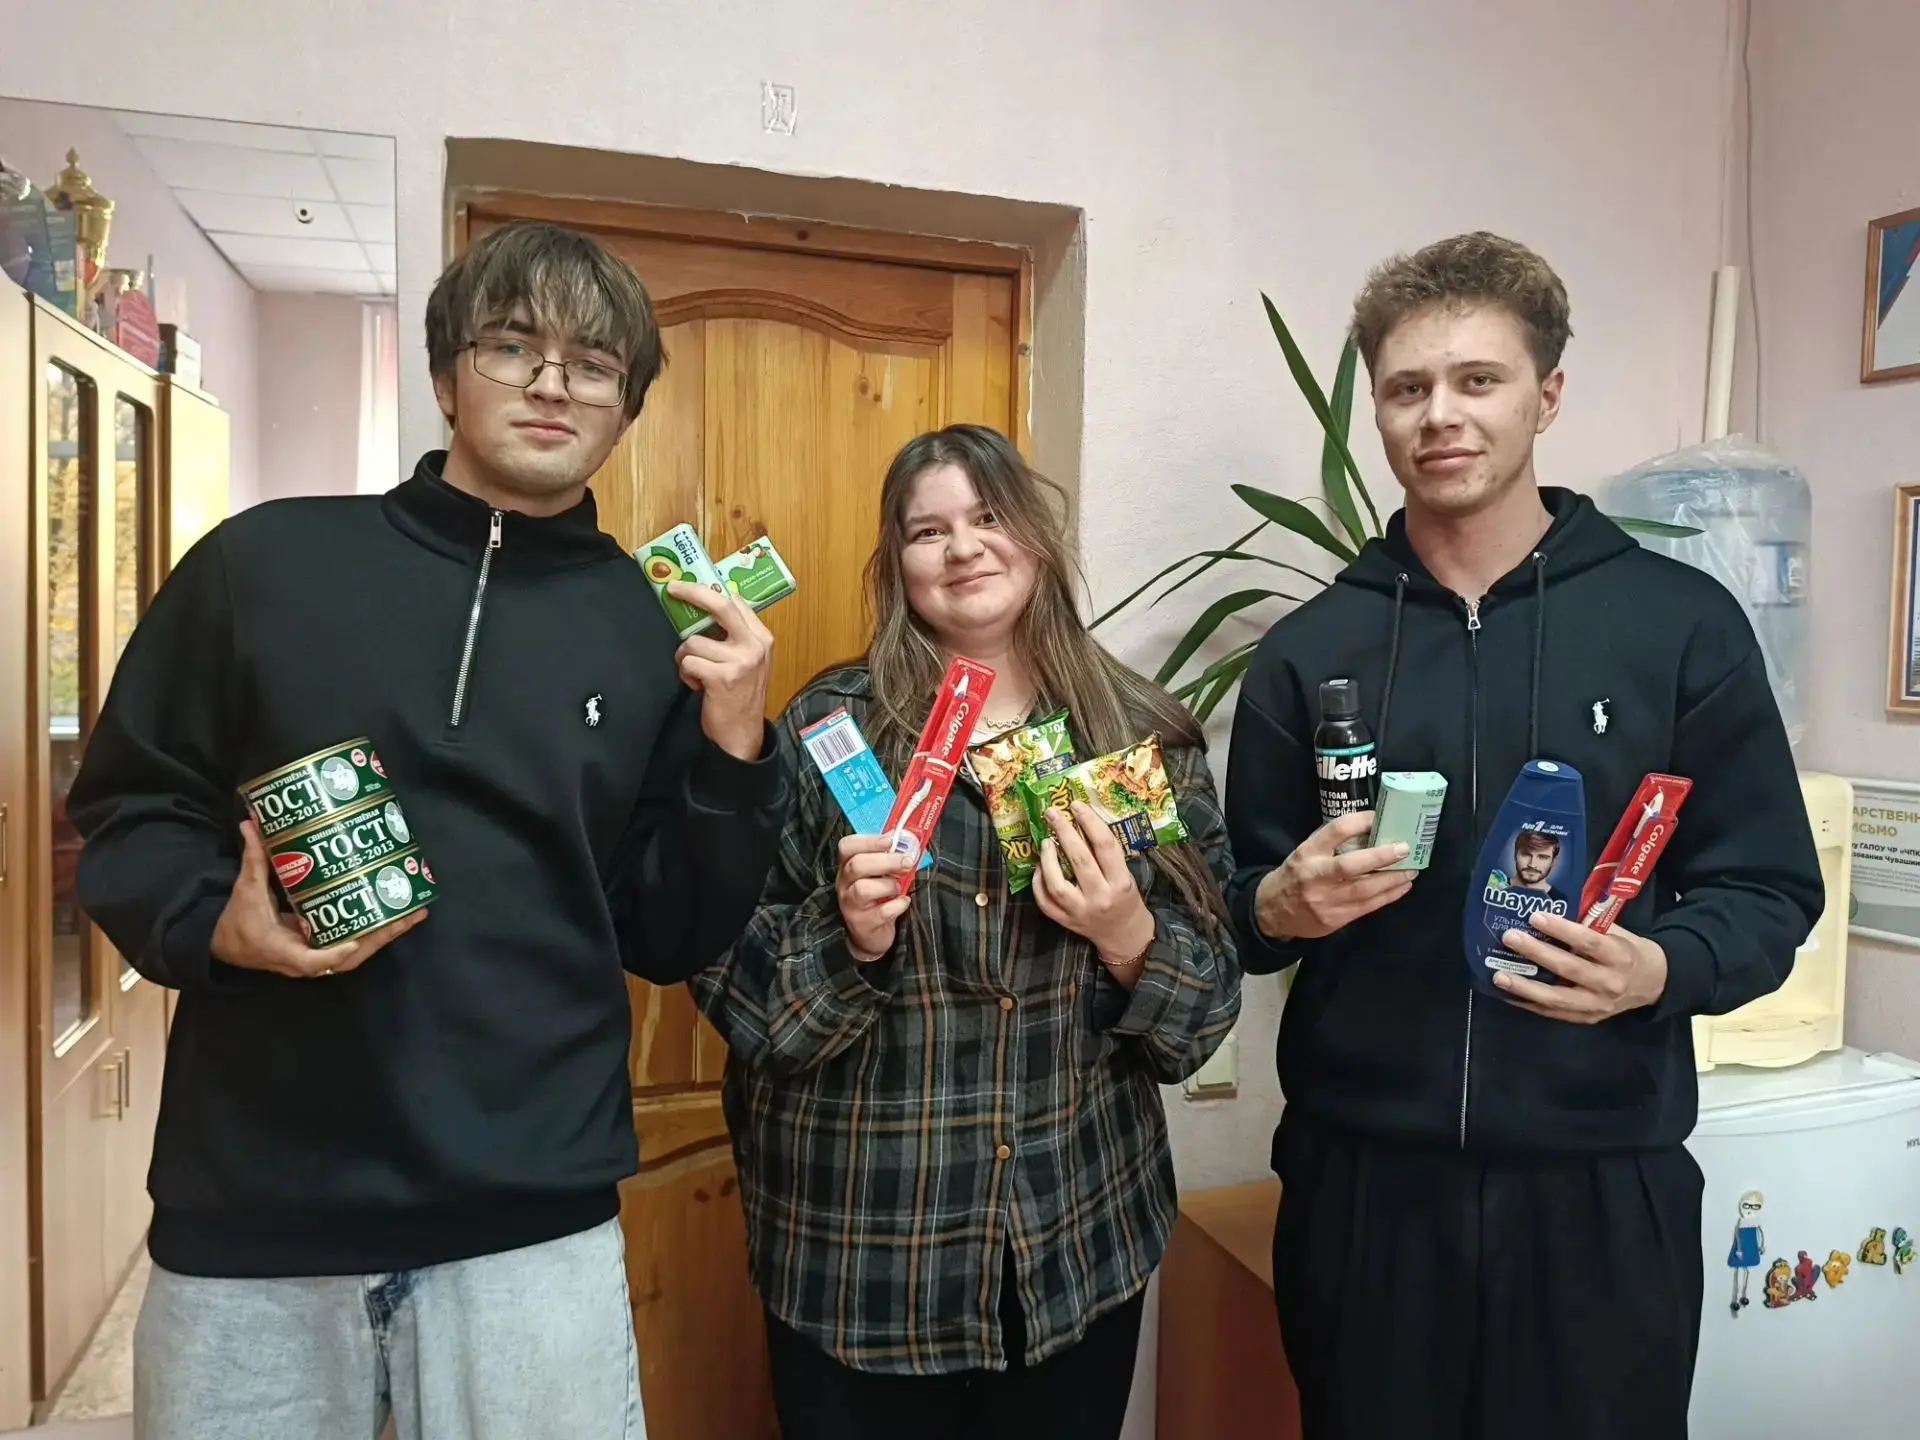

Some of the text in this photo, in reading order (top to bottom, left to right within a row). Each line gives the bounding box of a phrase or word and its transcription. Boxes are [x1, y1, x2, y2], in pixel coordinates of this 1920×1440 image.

[942, 702, 970, 757] Colgate
[1317, 754, 1377, 781] illette
[252, 778, 320, 824] ГОСТ
[1328, 791, 1348, 800] FOAM
[1342, 797, 1369, 808] БРИТЬЯ
[263, 800, 327, 835] 32125-2013
[310, 817, 387, 868] ГОСТ
[321, 840, 395, 879] 32125-2013
[1631, 824, 1664, 875] Colgate
[306, 886, 376, 934] ГОСТ
[1483, 886, 1568, 918] шаума
[315, 910, 385, 945] 32125-2013
